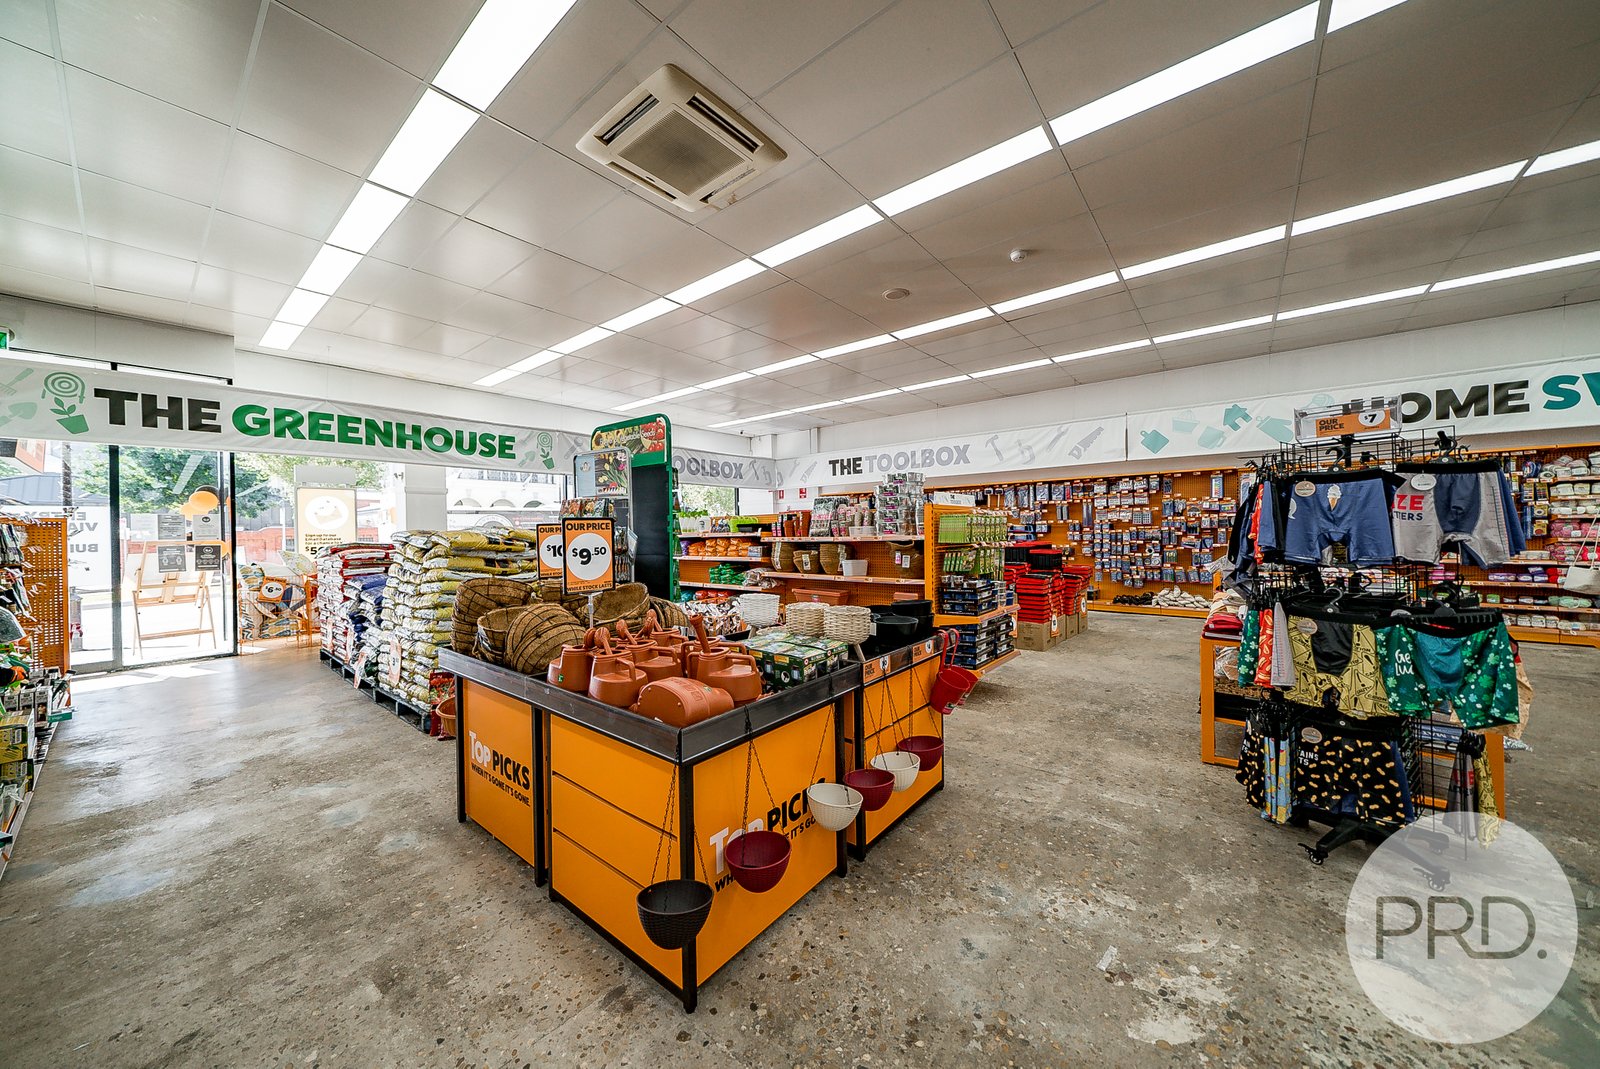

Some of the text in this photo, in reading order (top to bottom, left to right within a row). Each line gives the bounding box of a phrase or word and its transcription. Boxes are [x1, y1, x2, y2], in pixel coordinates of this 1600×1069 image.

[93, 388, 517, 460] THE GREENHOUSE
[1319, 423, 1344, 431] PRICE
[1364, 413, 1377, 423] $7
[672, 455, 744, 480] OOLBOX
[828, 444, 971, 477] THE TOOLBOX
[1391, 493, 1425, 511] ZE
[1393, 511, 1424, 521] TTERS
[566, 522, 611, 531] OUR PRICE
[305, 546, 324, 555] $5
[572, 546, 607, 565] $9.50
[1394, 648, 1412, 664] Ge
[1298, 757, 1309, 766] TS
[1299, 750, 1319, 761] AINS
[471, 762, 484, 777] WHEN
[483, 770, 492, 782] IT'S
[491, 776, 505, 791] GONE
[505, 784, 514, 796] IT'S
[492, 749, 530, 791] PICKS
[767, 777, 826, 832] PIC
[714, 873, 735, 893] WH
